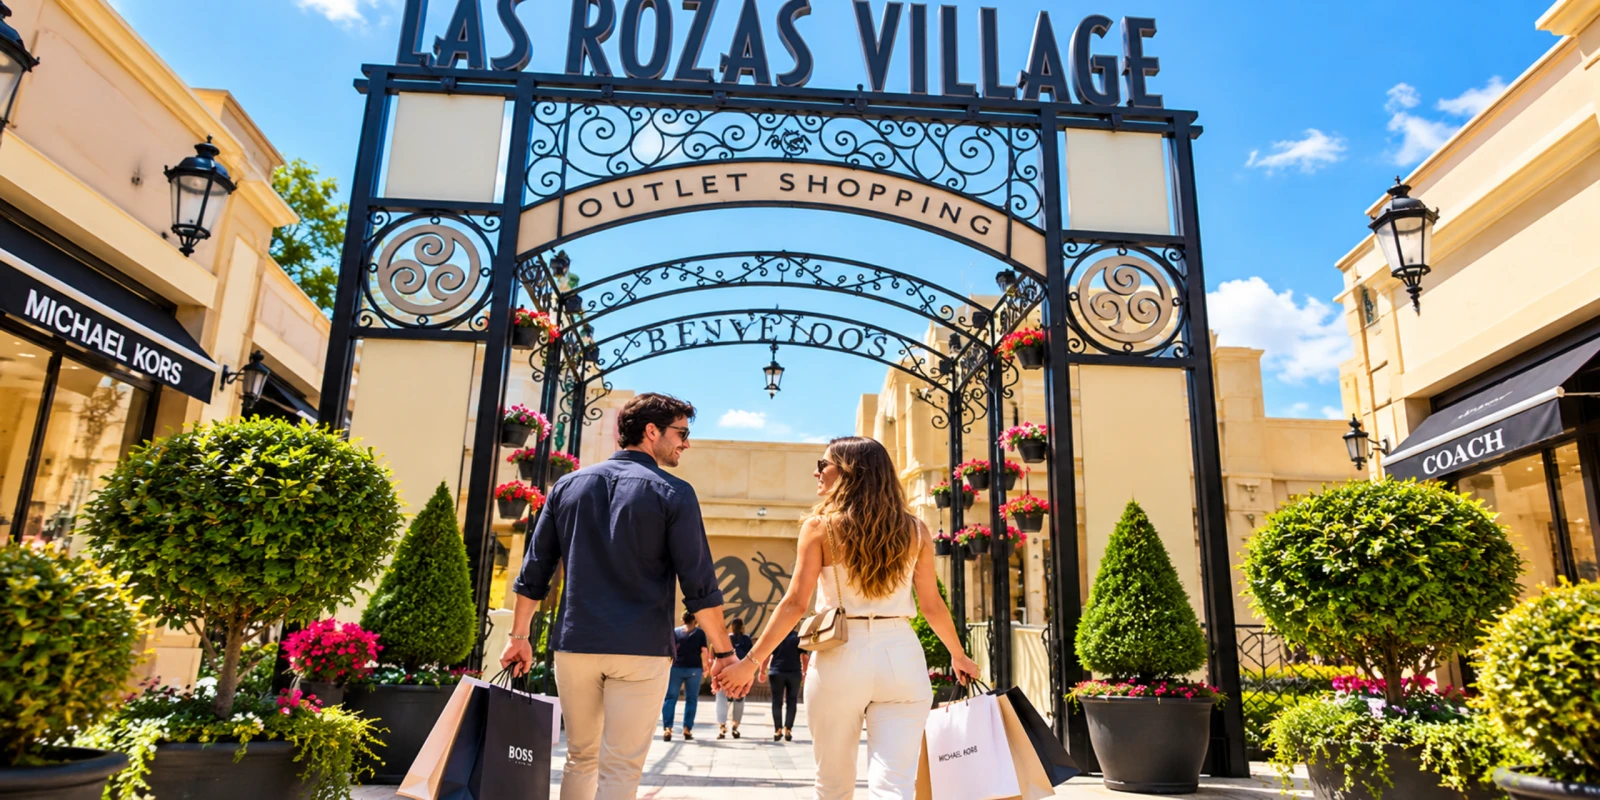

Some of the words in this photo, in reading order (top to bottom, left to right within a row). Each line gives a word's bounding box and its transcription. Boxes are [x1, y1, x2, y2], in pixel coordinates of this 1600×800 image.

[397, 0, 533, 71] LAS
[566, 0, 814, 87] ROZAS
[852, 0, 1163, 108] VILLAGE
[578, 172, 748, 219] OUTLET
[778, 173, 993, 235] SHOPPING
[24, 288, 128, 362] MICHAEL
[132, 342, 183, 385] KORS
[1422, 428, 1505, 475] COACH
[508, 745, 533, 762] BOSS
